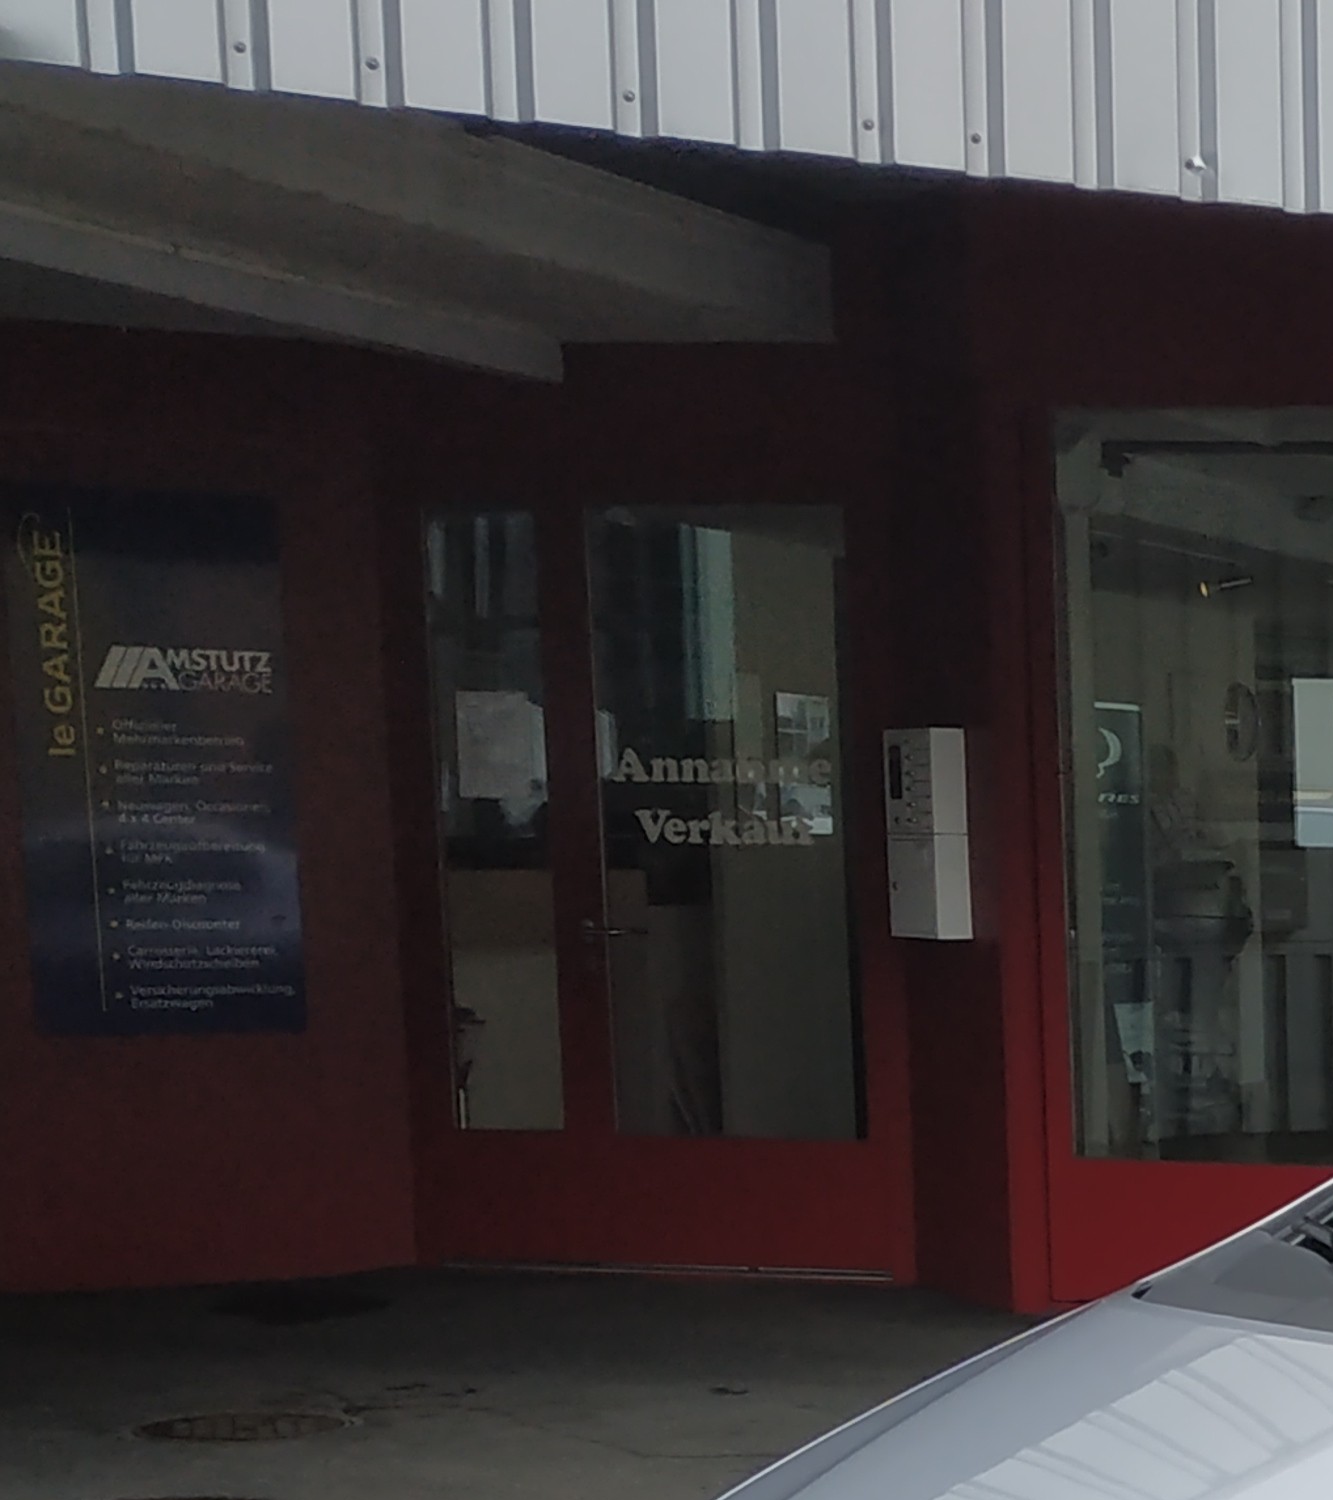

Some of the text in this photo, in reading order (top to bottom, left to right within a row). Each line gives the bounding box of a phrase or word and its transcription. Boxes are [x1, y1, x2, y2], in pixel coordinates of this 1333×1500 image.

[33, 529, 77, 758] le GARAGE
[127, 644, 272, 690] AMSTUTZ
[178, 670, 273, 695] GARAGE
[634, 808, 815, 846] Verkauf
